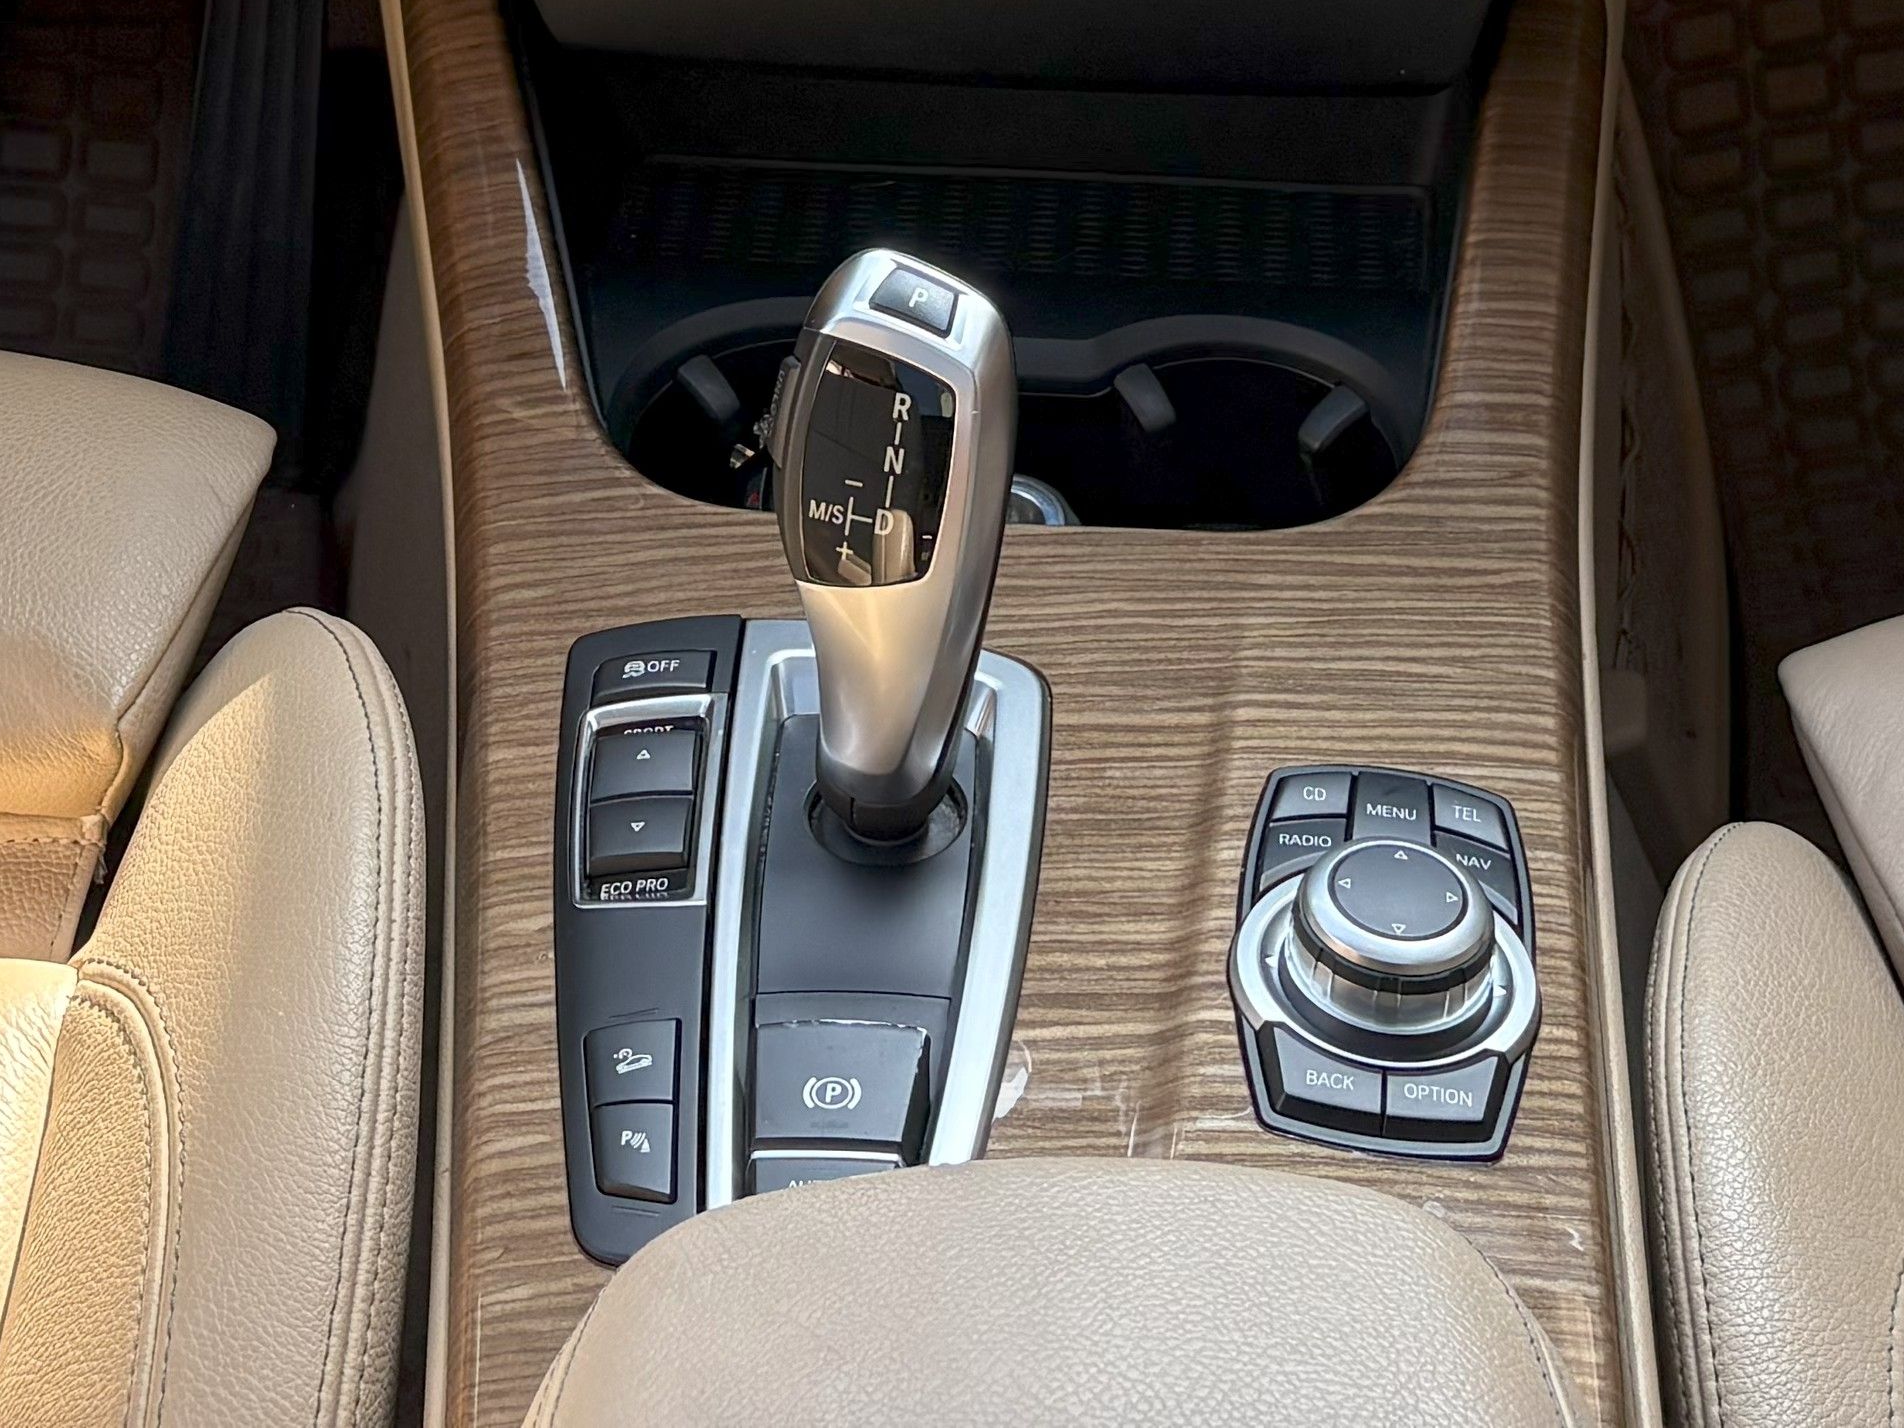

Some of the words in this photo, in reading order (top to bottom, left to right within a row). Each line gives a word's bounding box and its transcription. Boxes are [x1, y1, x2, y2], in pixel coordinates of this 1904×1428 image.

[908, 287, 927, 307] P
[892, 393, 911, 421] R
[884, 446, 904, 474] N
[808, 499, 844, 524] M/S
[874, 508, 894, 536] D
[647, 659, 680, 672] OFF
[1303, 786, 1326, 802] CD
[1366, 803, 1417, 821] MENU
[1454, 805, 1481, 823] TEL
[1279, 832, 1332, 848] RADIO
[1456, 853, 1492, 871] NAV
[600, 881, 632, 895] ECO
[636, 878, 669, 892] PRO
[1306, 1069, 1354, 1091] BACK
[1404, 1083, 1473, 1107] OPTION
